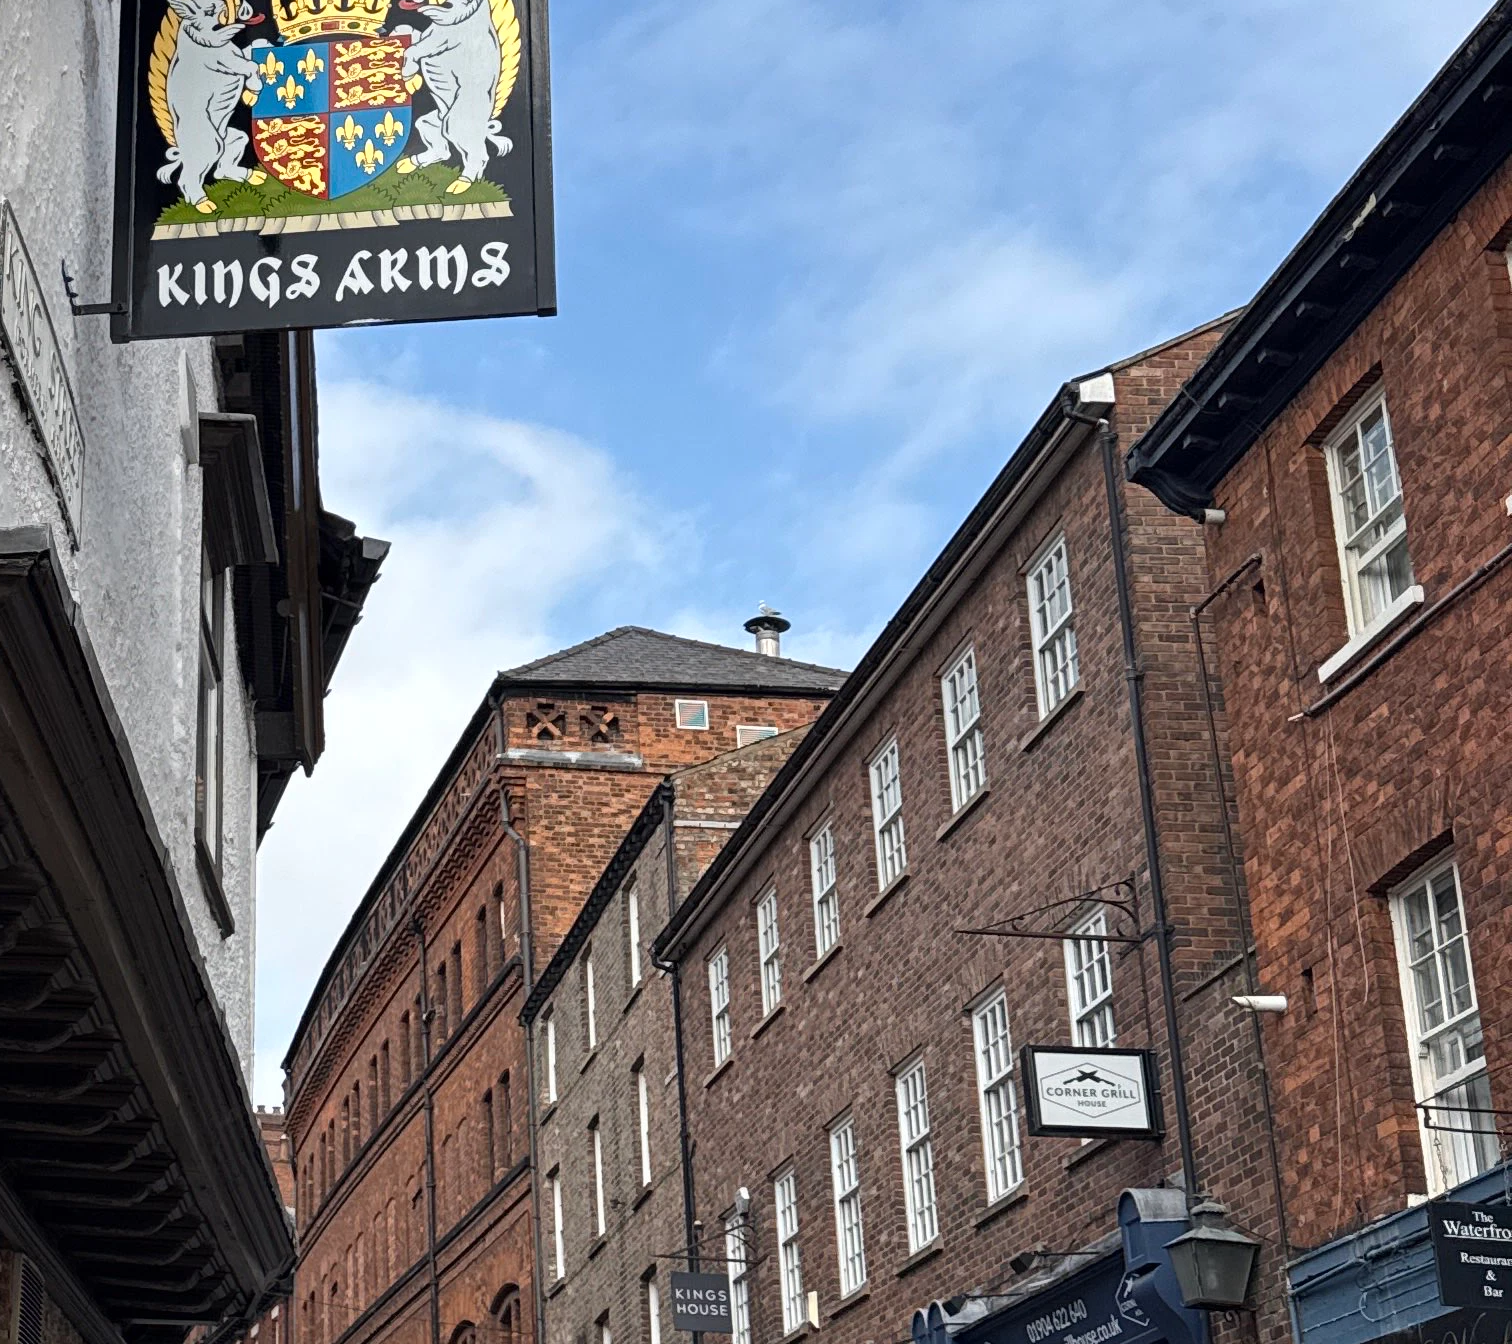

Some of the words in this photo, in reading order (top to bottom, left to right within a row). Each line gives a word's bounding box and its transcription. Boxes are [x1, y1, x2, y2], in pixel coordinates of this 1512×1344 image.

[157, 254, 320, 309] KINGS
[335, 241, 511, 302] ARMS
[4, 231, 43, 358] KING
[1046, 1087, 1097, 1098] CORNER
[1101, 1084, 1136, 1099] GRILL
[1077, 1099, 1107, 1108] HOUSE
[1472, 1211, 1494, 1223] The
[1442, 1220, 1512, 1239] Waterfro
[1485, 1270, 1497, 1281] &
[675, 1288, 727, 1302] KINGS
[1483, 1286, 1504, 1298] Bar
[676, 1303, 728, 1316] HOUSE
[1026, 1314, 1055, 1343] 01904
[1052, 1307, 1071, 1330] 622
[1068, 1299, 1088, 1323] 640
